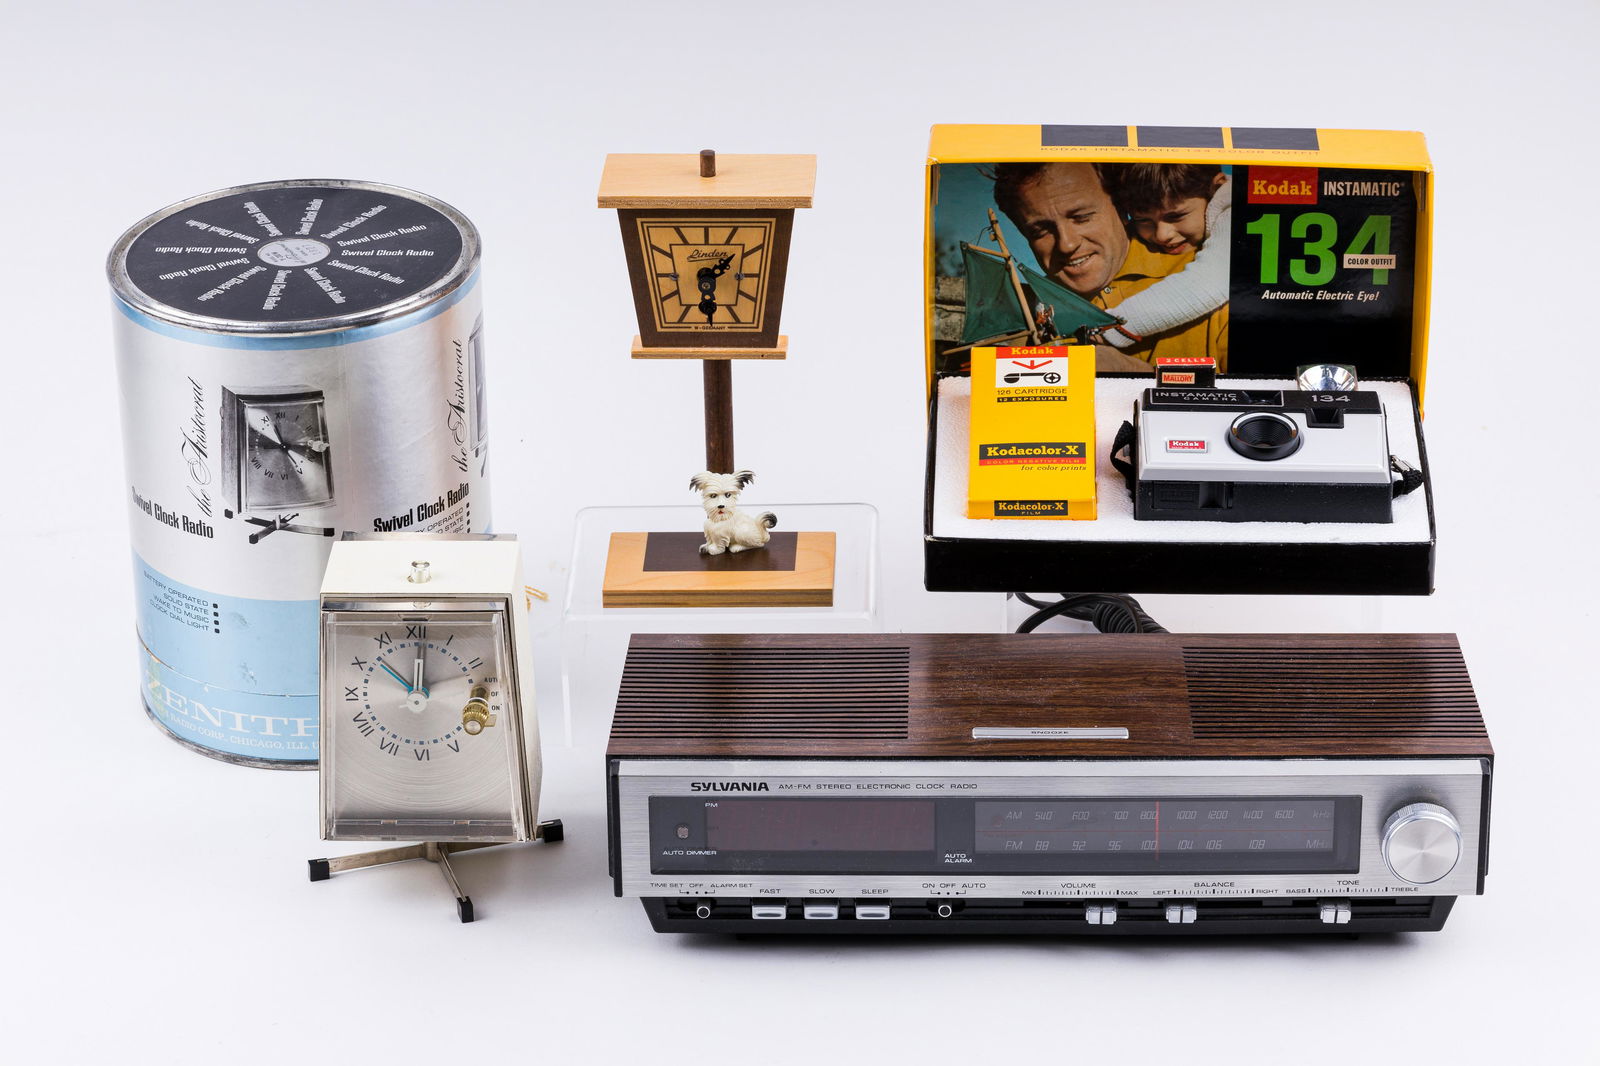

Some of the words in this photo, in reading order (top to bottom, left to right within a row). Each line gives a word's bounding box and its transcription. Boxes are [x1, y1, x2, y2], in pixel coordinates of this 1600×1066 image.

[1253, 180, 1312, 196] Kodak
[1324, 181, 1400, 196] INSTAMATIC
[337, 236, 371, 247] Swivel
[370, 230, 398, 240] Clock
[398, 224, 427, 235] Radio
[686, 249, 728, 262] Linden
[1246, 212, 1392, 286] 134
[1262, 290, 1314, 300] Automatic
[1316, 291, 1354, 300] Electric
[1356, 291, 1380, 302] Eye!
[447, 339, 467, 446] Aristocrat
[180, 376, 211, 485] Aristocrat
[986, 445, 1079, 457] Kodacolor-X
[451, 447, 468, 472] the
[187, 486, 212, 517] the
[374, 508, 413, 532] Swivel
[417, 496, 445, 522] Clock
[447, 482, 469, 508] Radio
[998, 502, 1064, 510] Kodacolor-X
[154, 503, 179, 529] Clock
[182, 515, 214, 538] Radio
[168, 588, 208, 607] OPERATED
[173, 605, 182, 614] TO
[184, 610, 209, 623] MUSIC
[185, 603, 209, 615] STATE
[170, 612, 185, 623] DIAL
[187, 620, 209, 631] LIGHT
[374, 631, 392, 649] XI
[406, 625, 426, 639] XII
[351, 656, 367, 671] X
[468, 657, 483, 669] II
[345, 686, 359, 701] IX
[353, 712, 375, 737] VIII
[380, 737, 399, 756] VII
[447, 740, 460, 752] V
[414, 749, 430, 761] VI
[691, 782, 769, 792] SYLVANIA
[1006, 811, 1022, 820] AM
[1034, 811, 1052, 820] 540
[1072, 811, 1090, 820] 600
[1113, 811, 1128, 820] 700
[1140, 810, 1157, 820] 800
[1177, 810, 1197, 820] 1000
[1208, 810, 1228, 820] 1200
[1275, 810, 1294, 819] 1600
[1005, 840, 1023, 850] FM
[1035, 840, 1050, 850] 88
[1072, 840, 1086, 850] 92
[1108, 840, 1121, 850] 96
[1141, 840, 1158, 850] 100
[1178, 840, 1193, 850] 104
[1206, 840, 1222, 849] 106
[1249, 840, 1266, 849] 108
